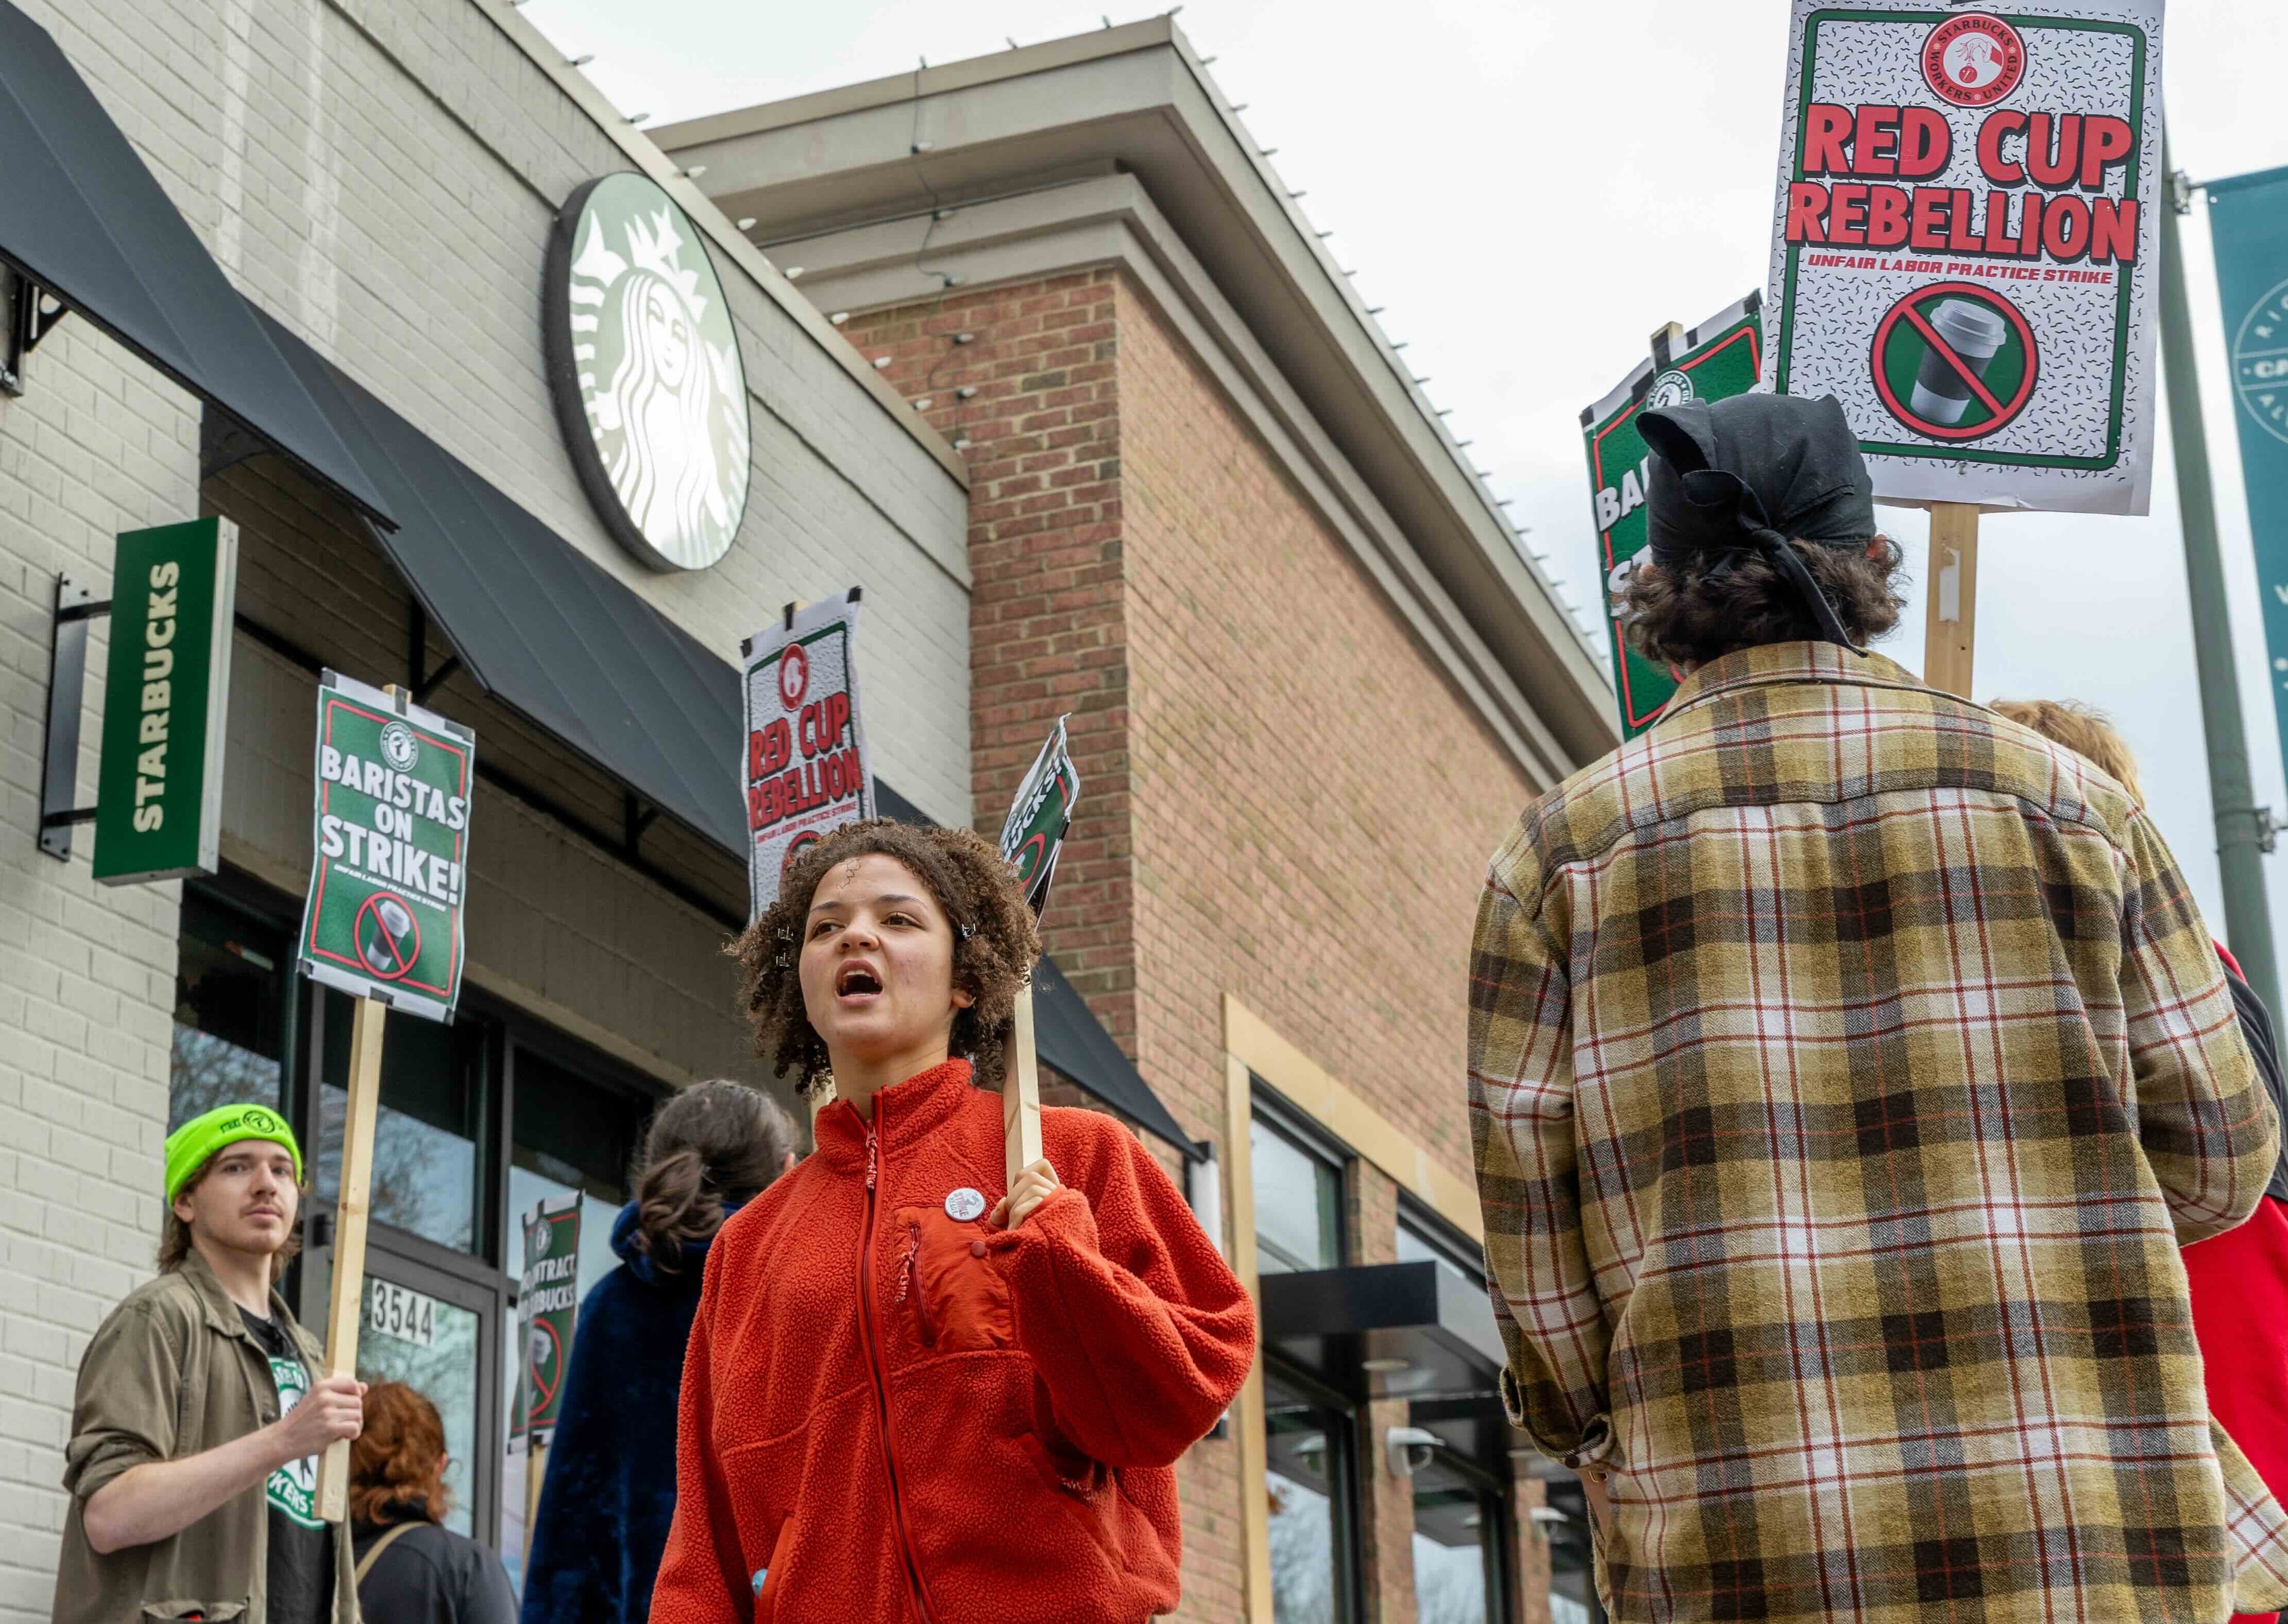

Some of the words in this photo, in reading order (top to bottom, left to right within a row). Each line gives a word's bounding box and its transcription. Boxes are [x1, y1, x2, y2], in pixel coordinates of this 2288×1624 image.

[1938, 19, 2014, 46] STARBUCKS
[1929, 51, 1972, 101] WORKERS
[1982, 55, 2017, 99] UNITED
[1802, 104, 1953, 181] RED
[1976, 110, 2138, 192] CUP
[1785, 181, 2139, 266] REBELLION
[1808, 254, 1877, 269] UNFAIR
[1879, 259, 1943, 274] LABOR
[1947, 263, 2041, 281] PRACTICE
[2043, 269, 2113, 284] STRIKE
[133, 561, 179, 833] STARBUCKS
[750, 717, 791, 783] RED
[799, 691, 850, 761] CUP
[321, 744, 466, 831] BARISTAS
[375, 803, 412, 842] ON
[748, 746, 863, 832] REBELLION
[321, 814, 461, 906] STRIKE!
[375, 1284, 431, 1344] 3544
[269, 1471, 309, 1514] KERS
